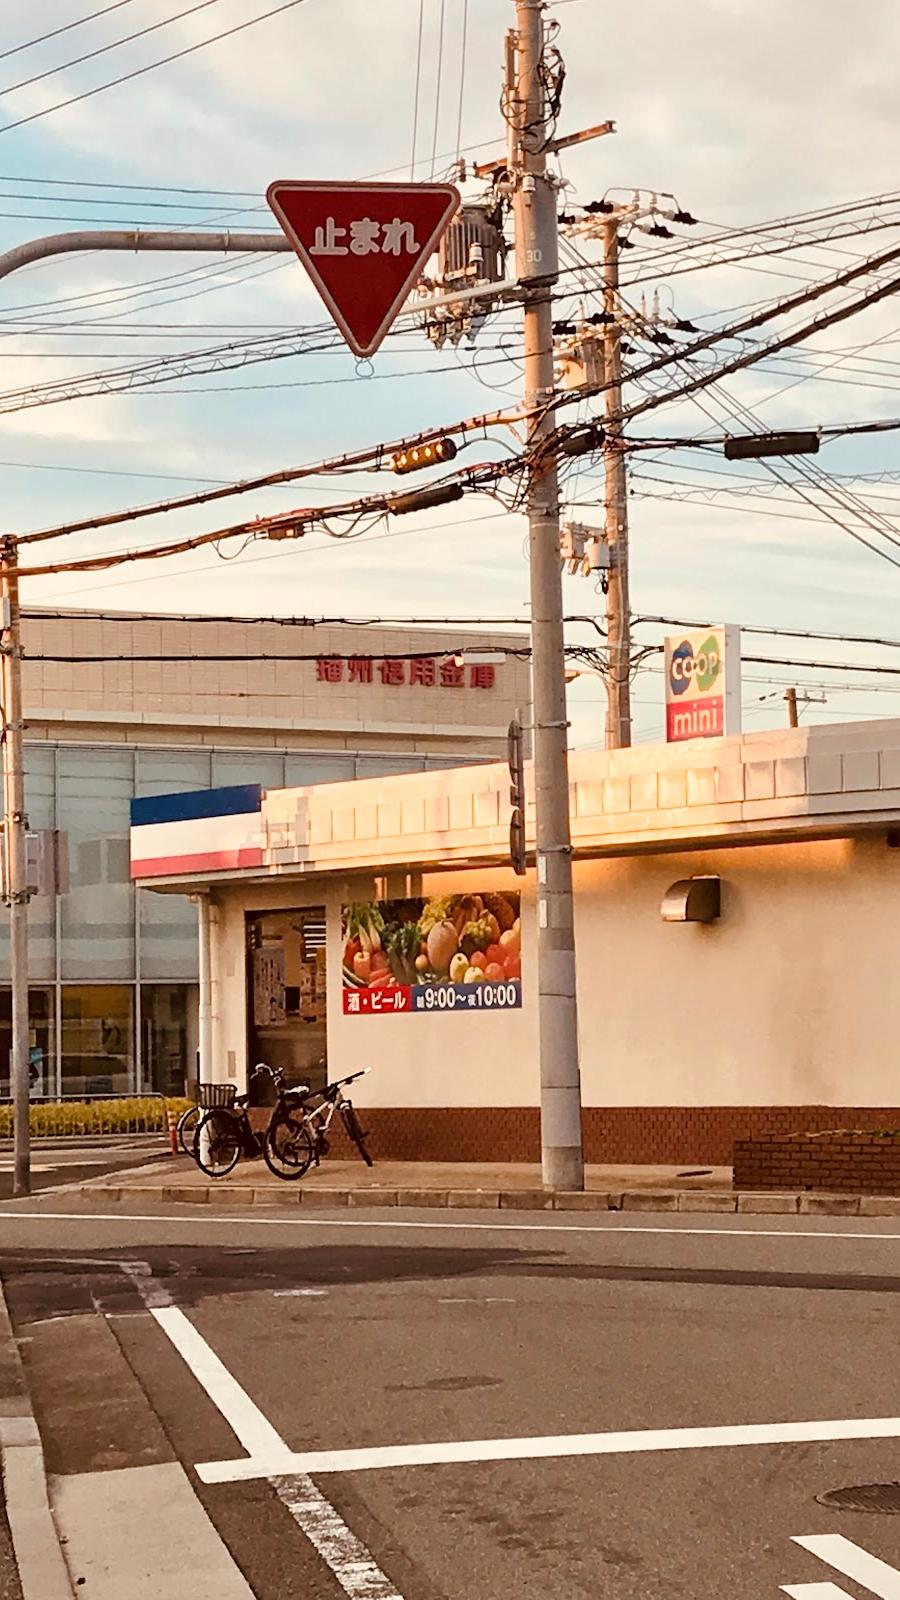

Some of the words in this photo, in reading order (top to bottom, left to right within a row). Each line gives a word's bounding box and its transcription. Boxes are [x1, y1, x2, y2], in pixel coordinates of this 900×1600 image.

[309, 216, 421, 256] 止まれ
[526, 249, 543, 263] 30
[673, 699, 718, 736] mini
[347, 990, 407, 1013] 酒・ビール
